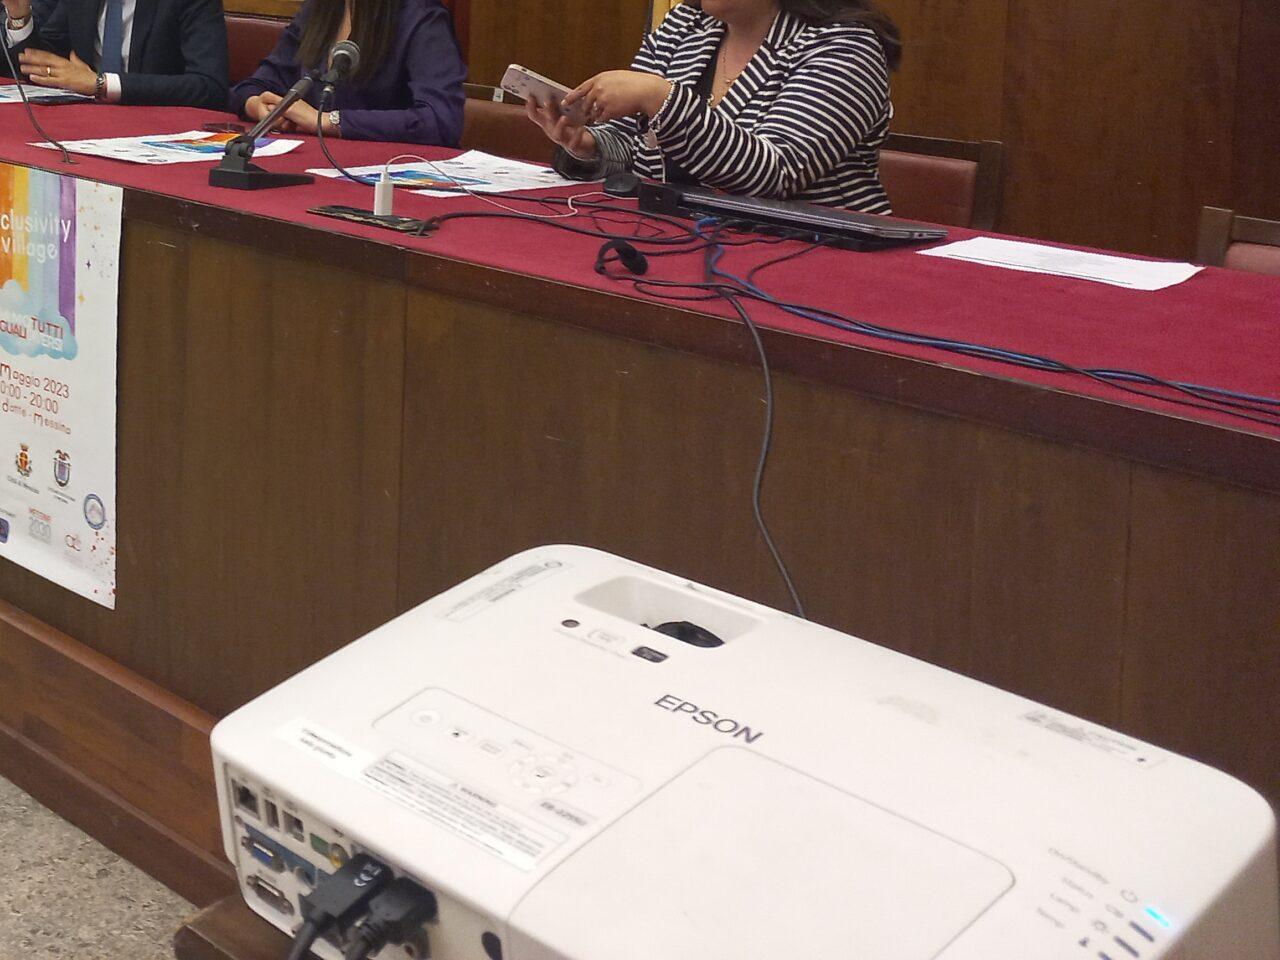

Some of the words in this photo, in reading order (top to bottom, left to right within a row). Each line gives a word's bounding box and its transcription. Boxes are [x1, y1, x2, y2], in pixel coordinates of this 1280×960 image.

[30, 316, 64, 340] TUTTI
[43, 377, 70, 399] 2023
[30, 391, 59, 415] 20:00
[654, 694, 764, 744] EPSON
